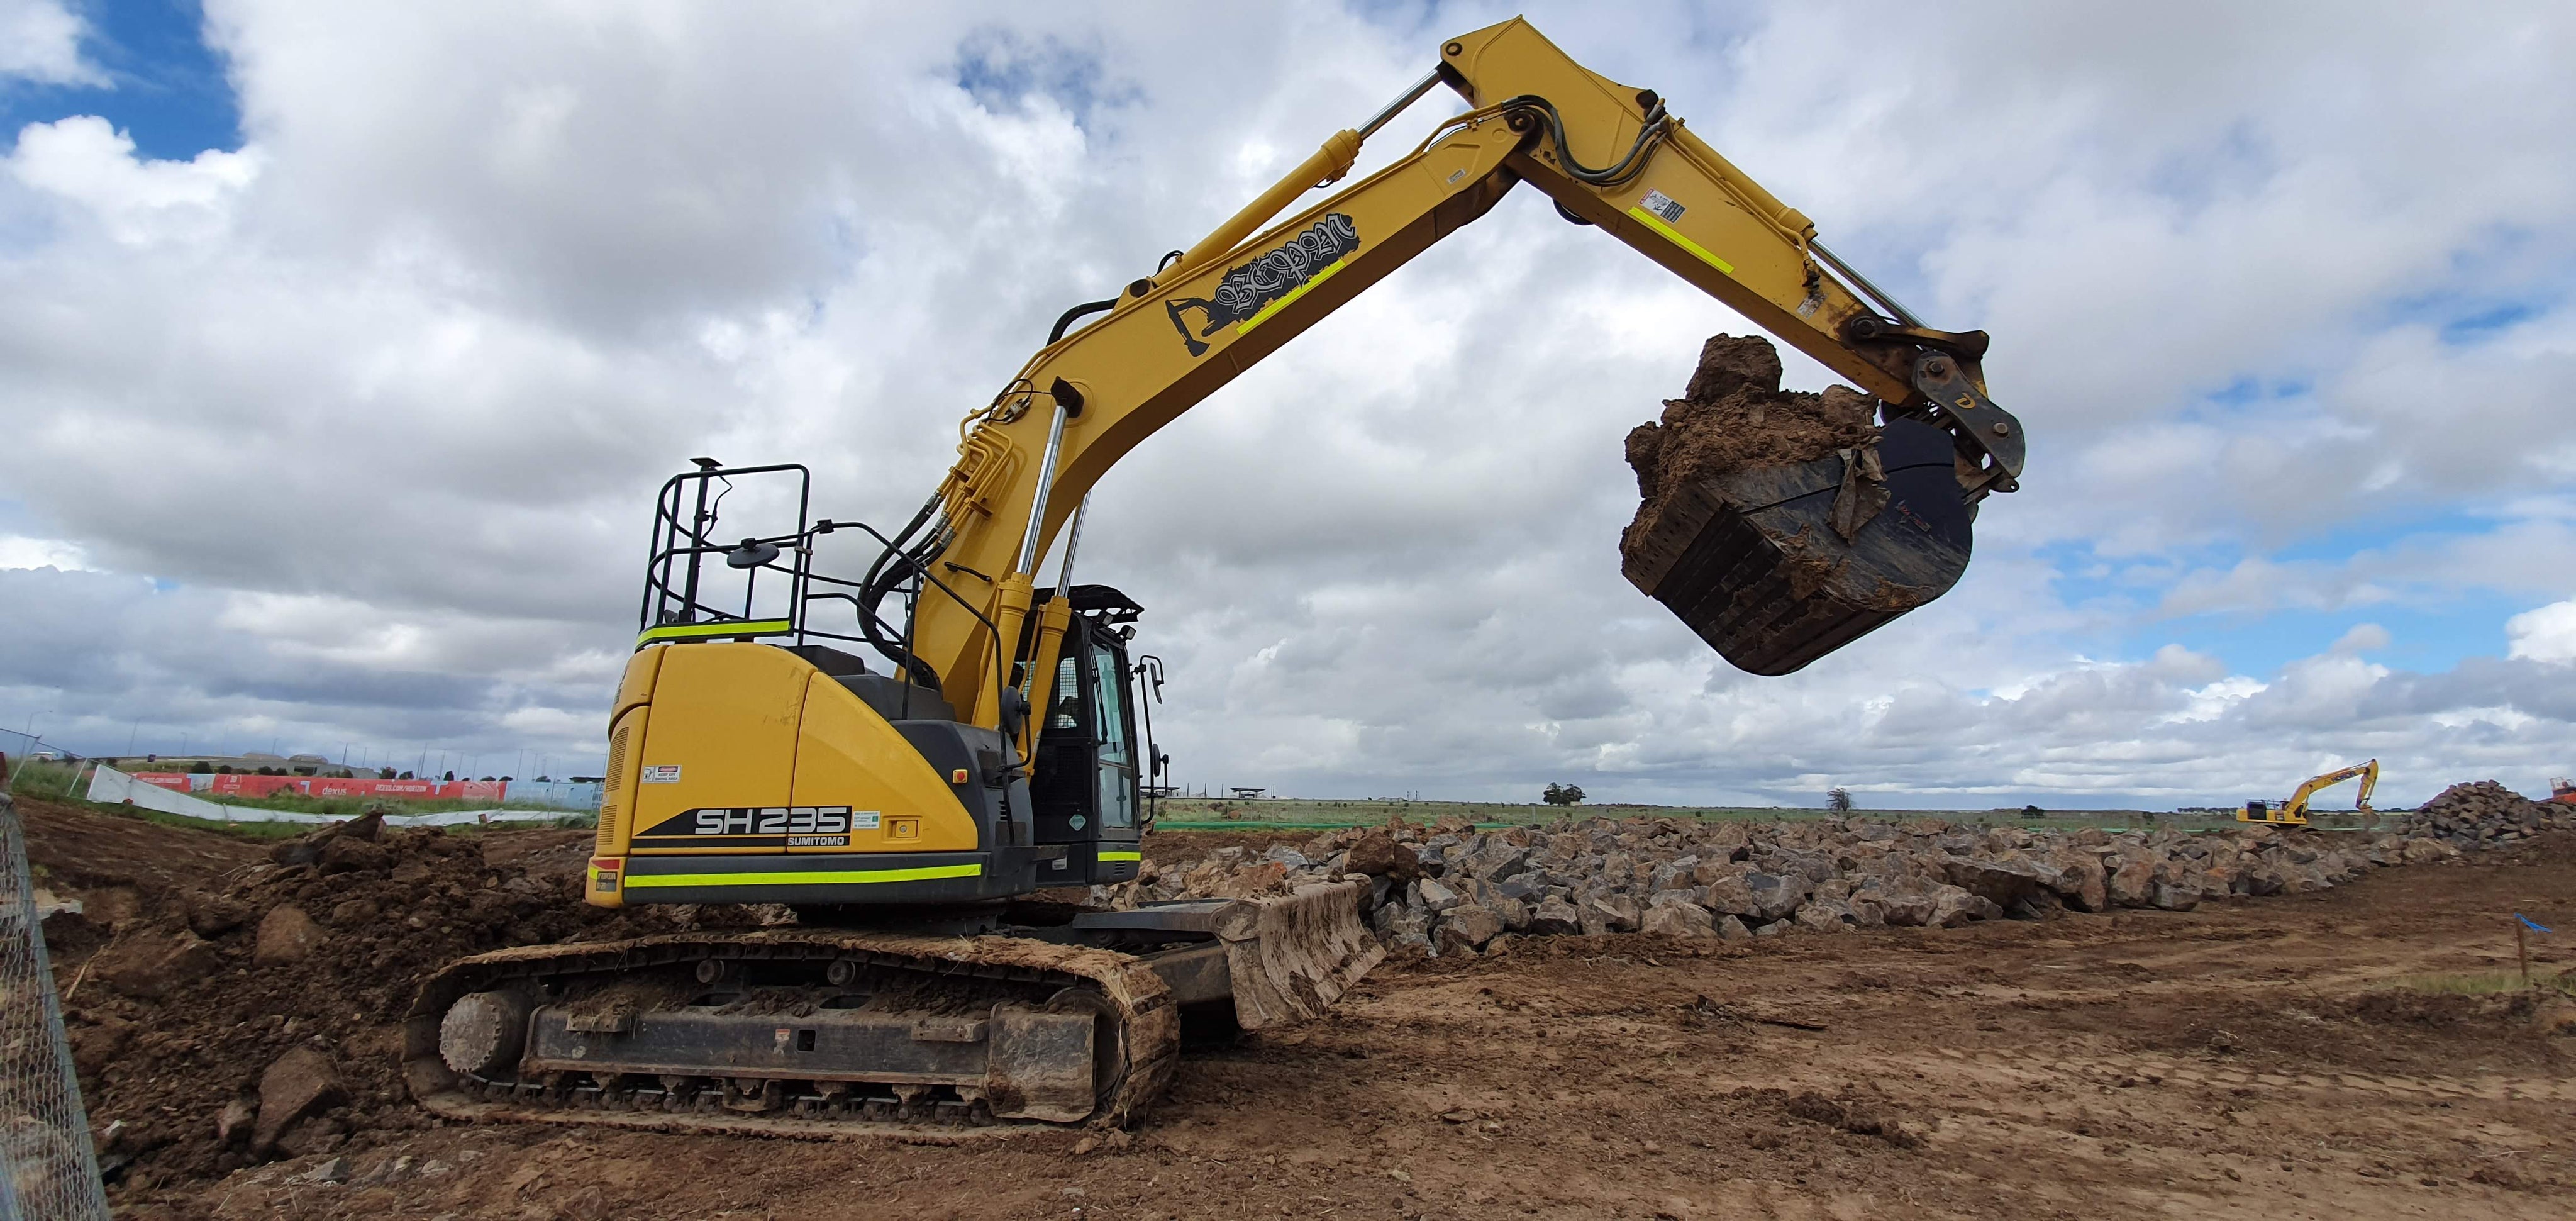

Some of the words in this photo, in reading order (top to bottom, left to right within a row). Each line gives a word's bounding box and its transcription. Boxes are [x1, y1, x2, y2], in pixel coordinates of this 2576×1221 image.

[322, 785, 347, 796] dexus
[695, 809, 753, 834] SH
[758, 807, 847, 834] 235
[787, 837, 845, 846] SUMITOMO
